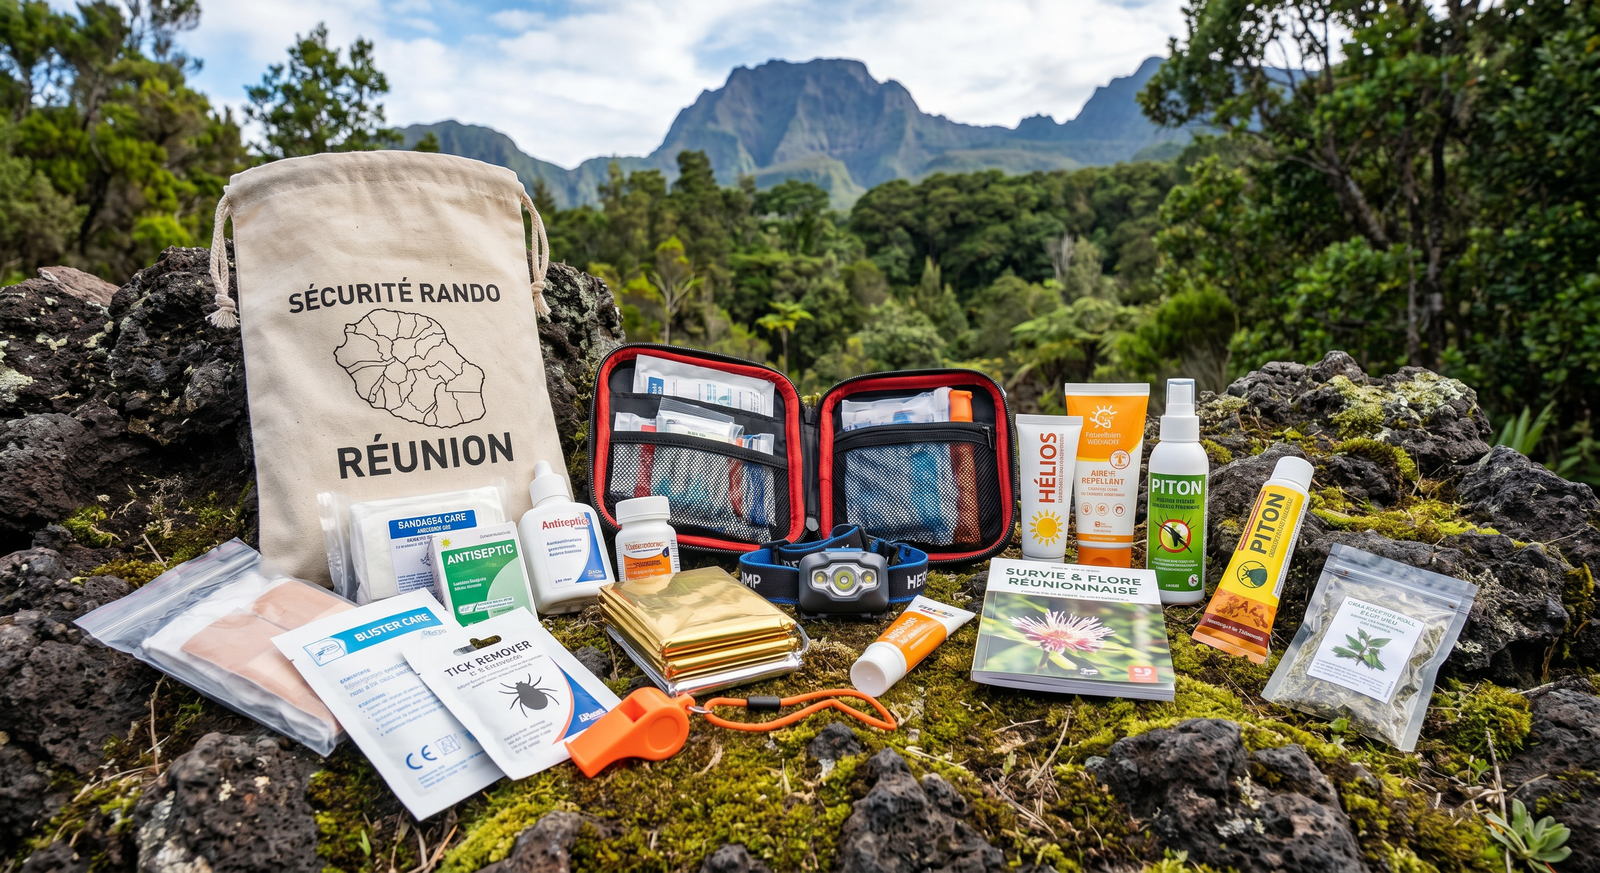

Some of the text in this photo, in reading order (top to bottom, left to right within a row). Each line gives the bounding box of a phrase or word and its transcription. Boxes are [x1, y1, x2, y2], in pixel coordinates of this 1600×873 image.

[289, 277, 500, 313] SÉCURITÉ RANDO
[337, 432, 514, 479] RÉUNION
[1033, 432, 1057, 503] HÉLIOS
[1081, 477, 1124, 485] REPELLANT
[1152, 478, 1202, 495] PITON
[444, 513, 466, 523] CARE
[1249, 493, 1285, 554] PITON
[447, 544, 514, 565] ANTISEPTIC
[1006, 567, 1065, 580] SURVIE
[1071, 573, 1082, 581] &
[1088, 575, 1142, 586] FLORE
[1008, 577, 1138, 595] RÉUNIONNAISE
[354, 621, 401, 642] BLISTER
[402, 613, 431, 628] CARE
[444, 661, 475, 677] TICK
[475, 640, 532, 665] REMOVER
